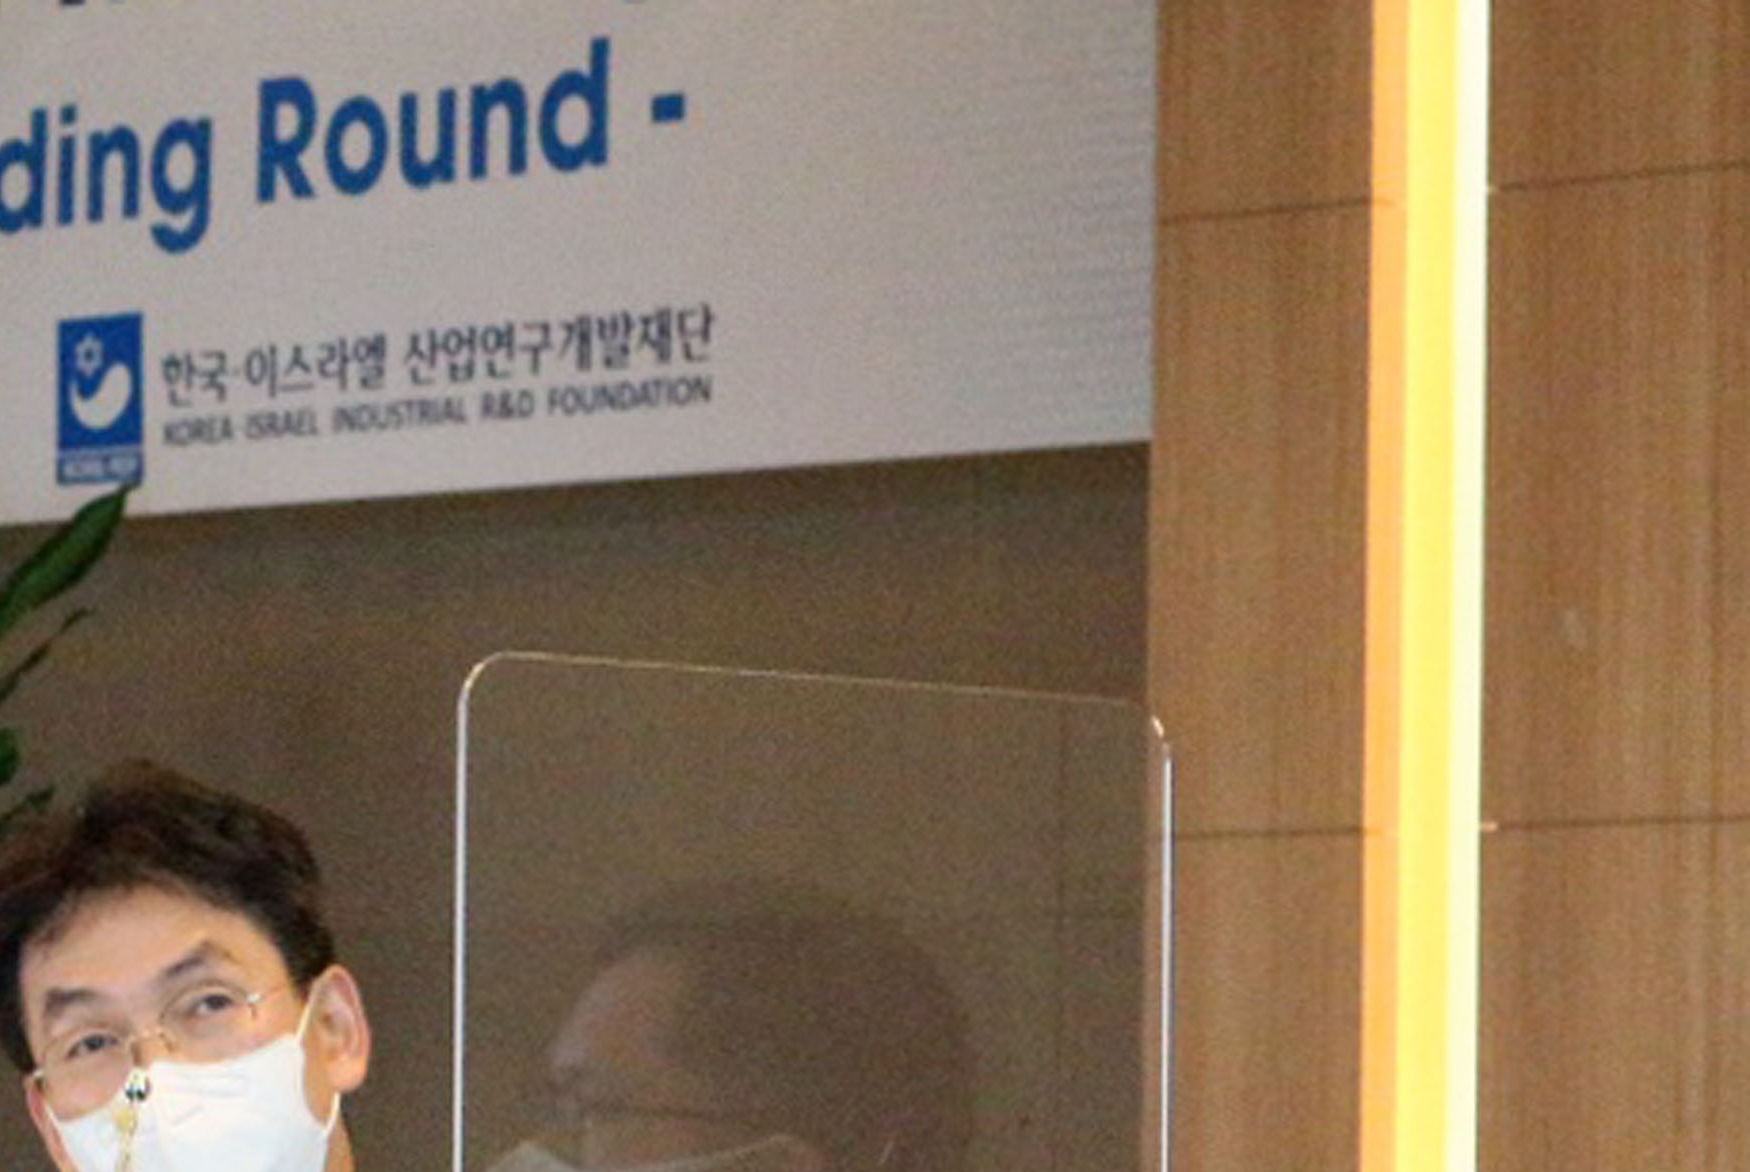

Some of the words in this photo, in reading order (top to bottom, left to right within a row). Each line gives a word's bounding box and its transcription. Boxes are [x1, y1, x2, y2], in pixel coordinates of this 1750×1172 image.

[254, 36, 611, 203] Round
[404, 304, 715, 387] 산업연구개발재단
[162, 415, 234, 446] KOREA
[245, 407, 320, 440] ISRAEL
[332, 396, 468, 434] INDUSTRIAL
[480, 389, 537, 420] R&D
[546, 374, 713, 416] FOUNDATION
